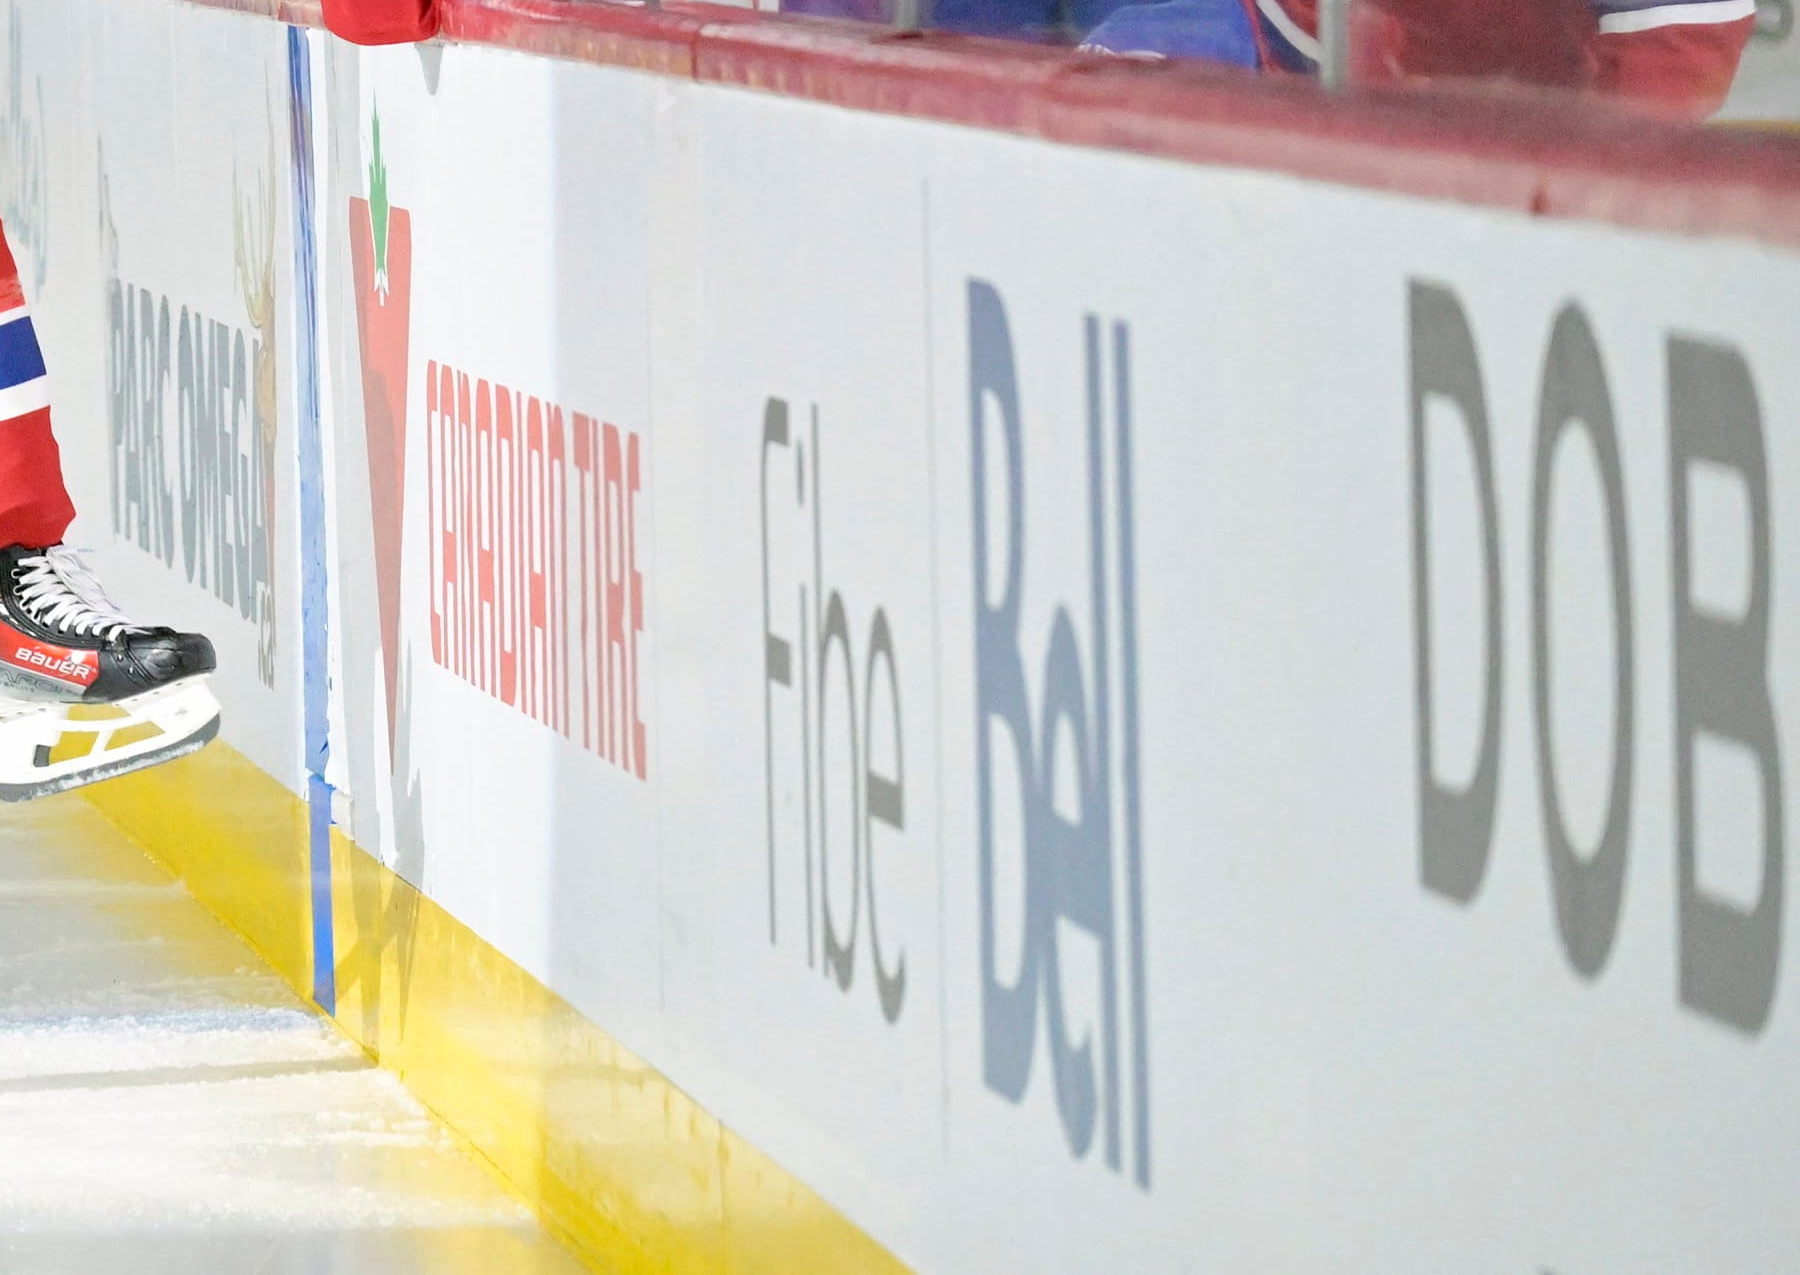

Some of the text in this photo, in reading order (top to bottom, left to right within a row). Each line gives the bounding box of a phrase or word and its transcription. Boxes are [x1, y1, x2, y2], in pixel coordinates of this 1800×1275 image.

[106, 277, 175, 571] PARC
[426, 358, 647, 782] CANADIAN TIRE
[15, 647, 91, 679] BAUER
[757, 276, 1151, 1194] Fibe Bell
[1403, 275, 1785, 1040] DOB
